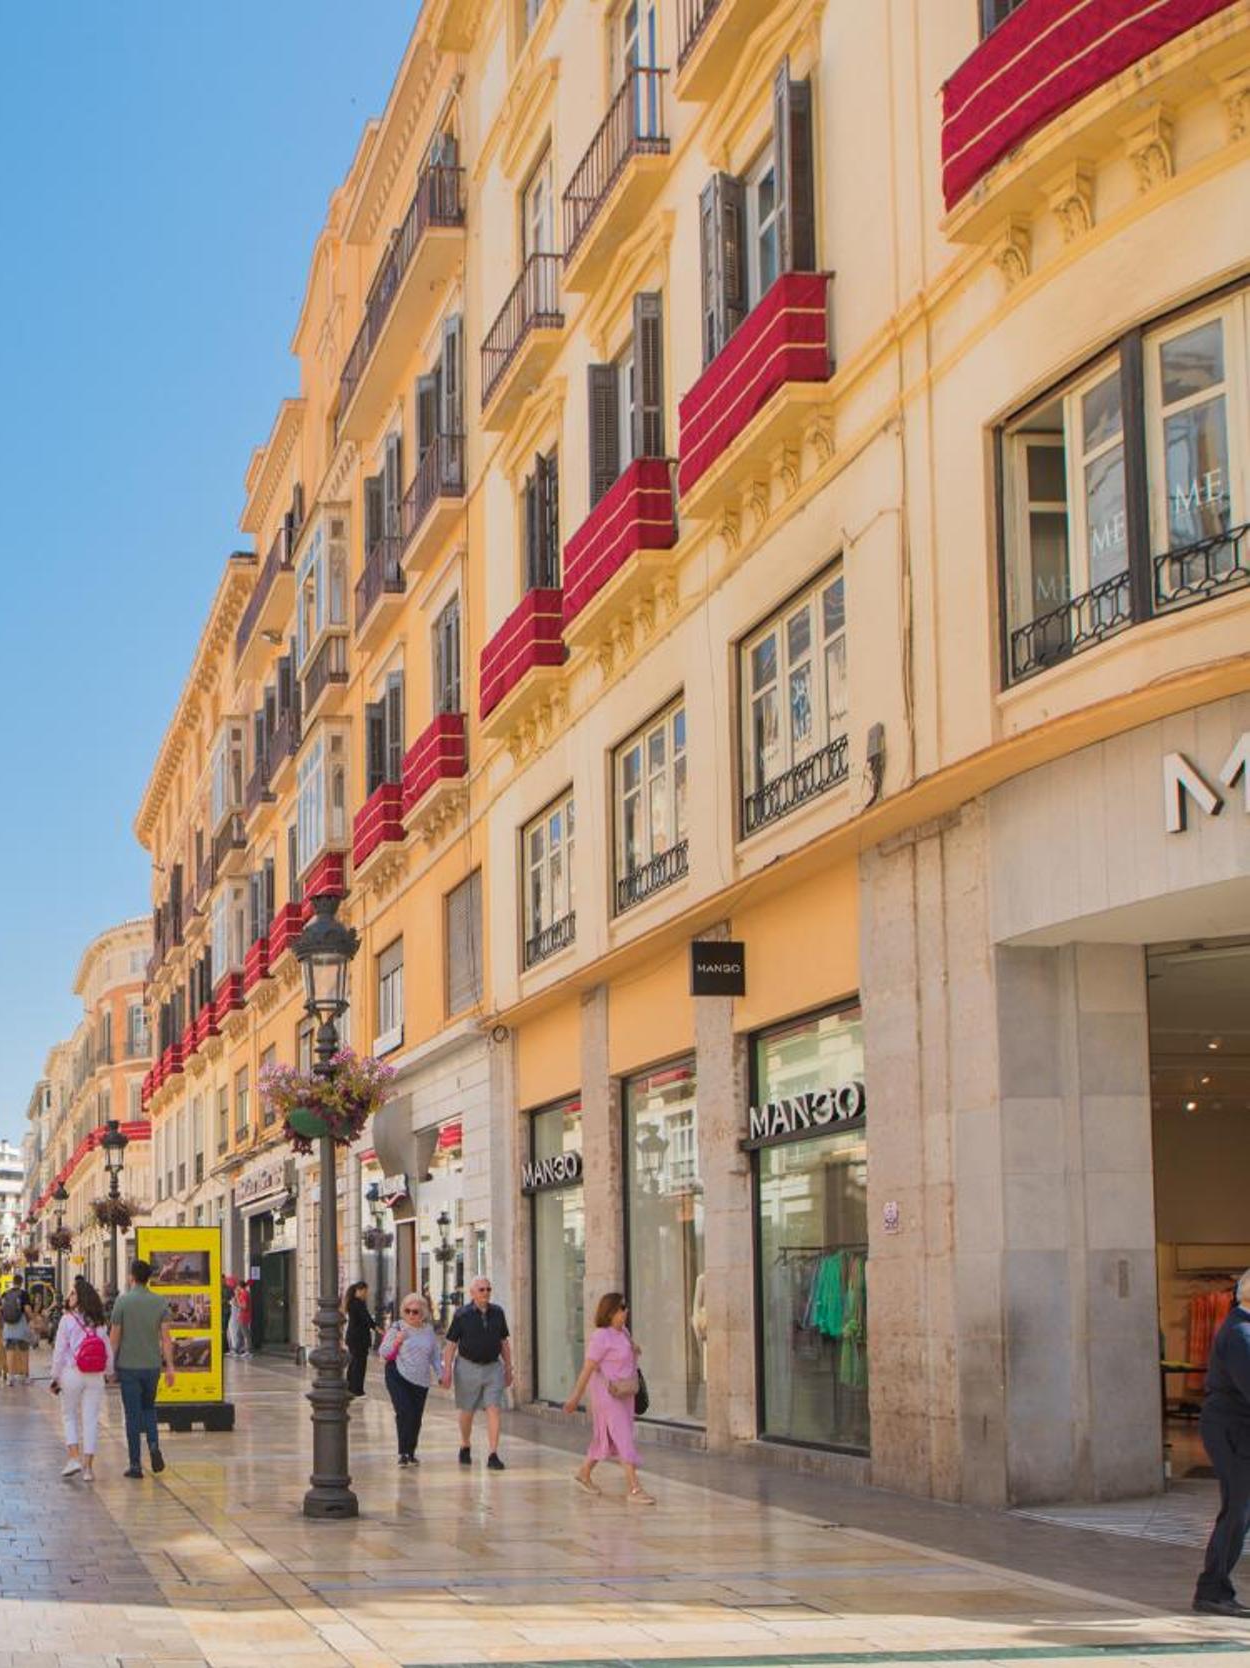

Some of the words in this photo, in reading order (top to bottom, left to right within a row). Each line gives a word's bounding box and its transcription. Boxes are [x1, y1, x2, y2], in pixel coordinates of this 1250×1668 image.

[697, 963, 741, 973] MANGO
[750, 1080, 860, 1140] MANGO
[522, 1153, 579, 1188] MANGO
